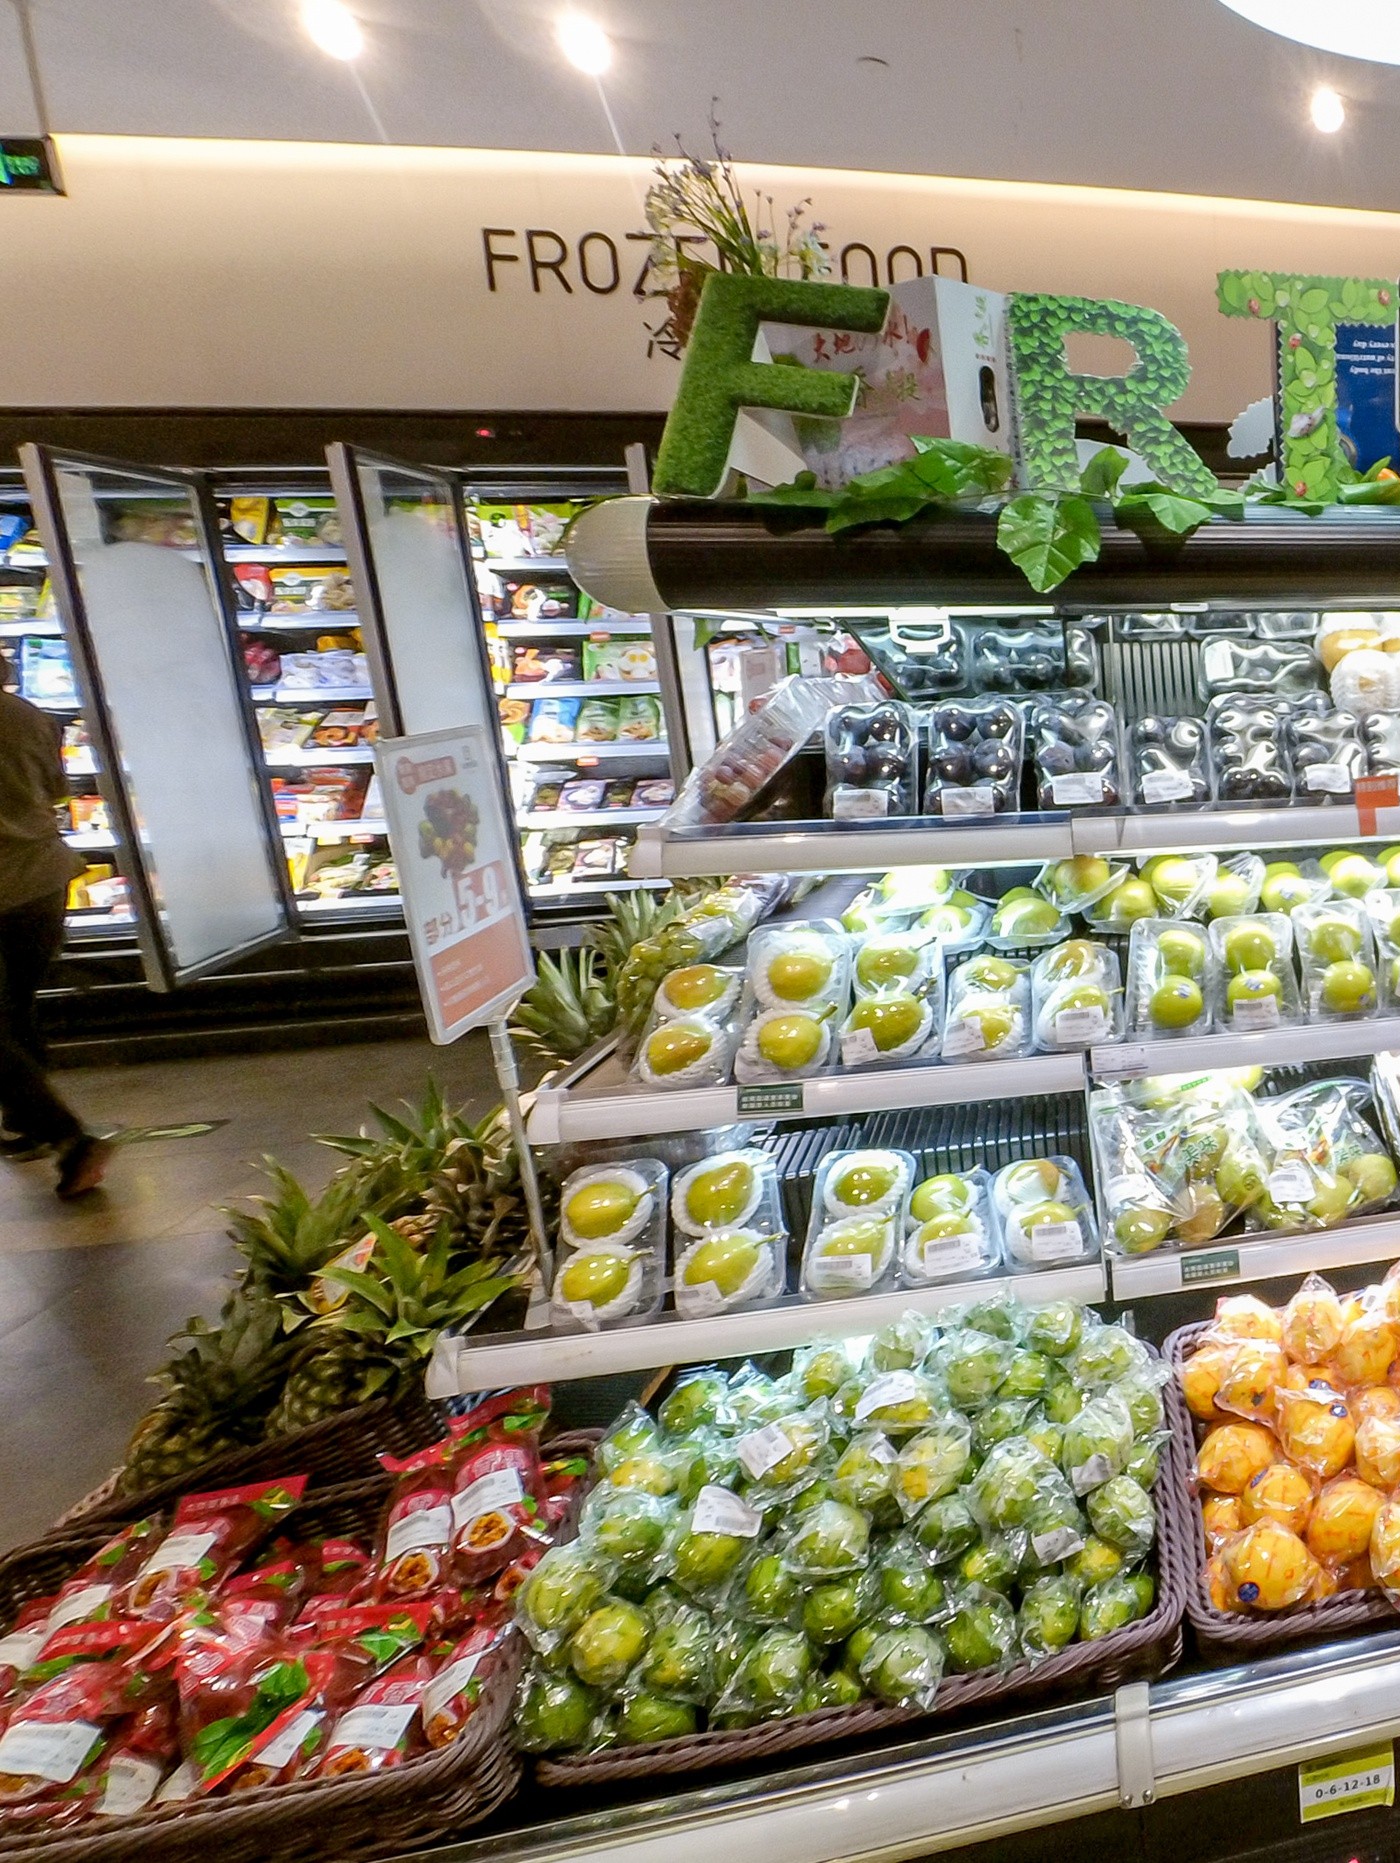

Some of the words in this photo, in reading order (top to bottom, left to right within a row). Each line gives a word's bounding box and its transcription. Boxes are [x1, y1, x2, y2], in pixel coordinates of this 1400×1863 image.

[803, 240, 968, 287] OOD
[1183, 1134, 1219, 1166] 美味
[1314, 1773, 1382, 1800] 0-6-12-18
